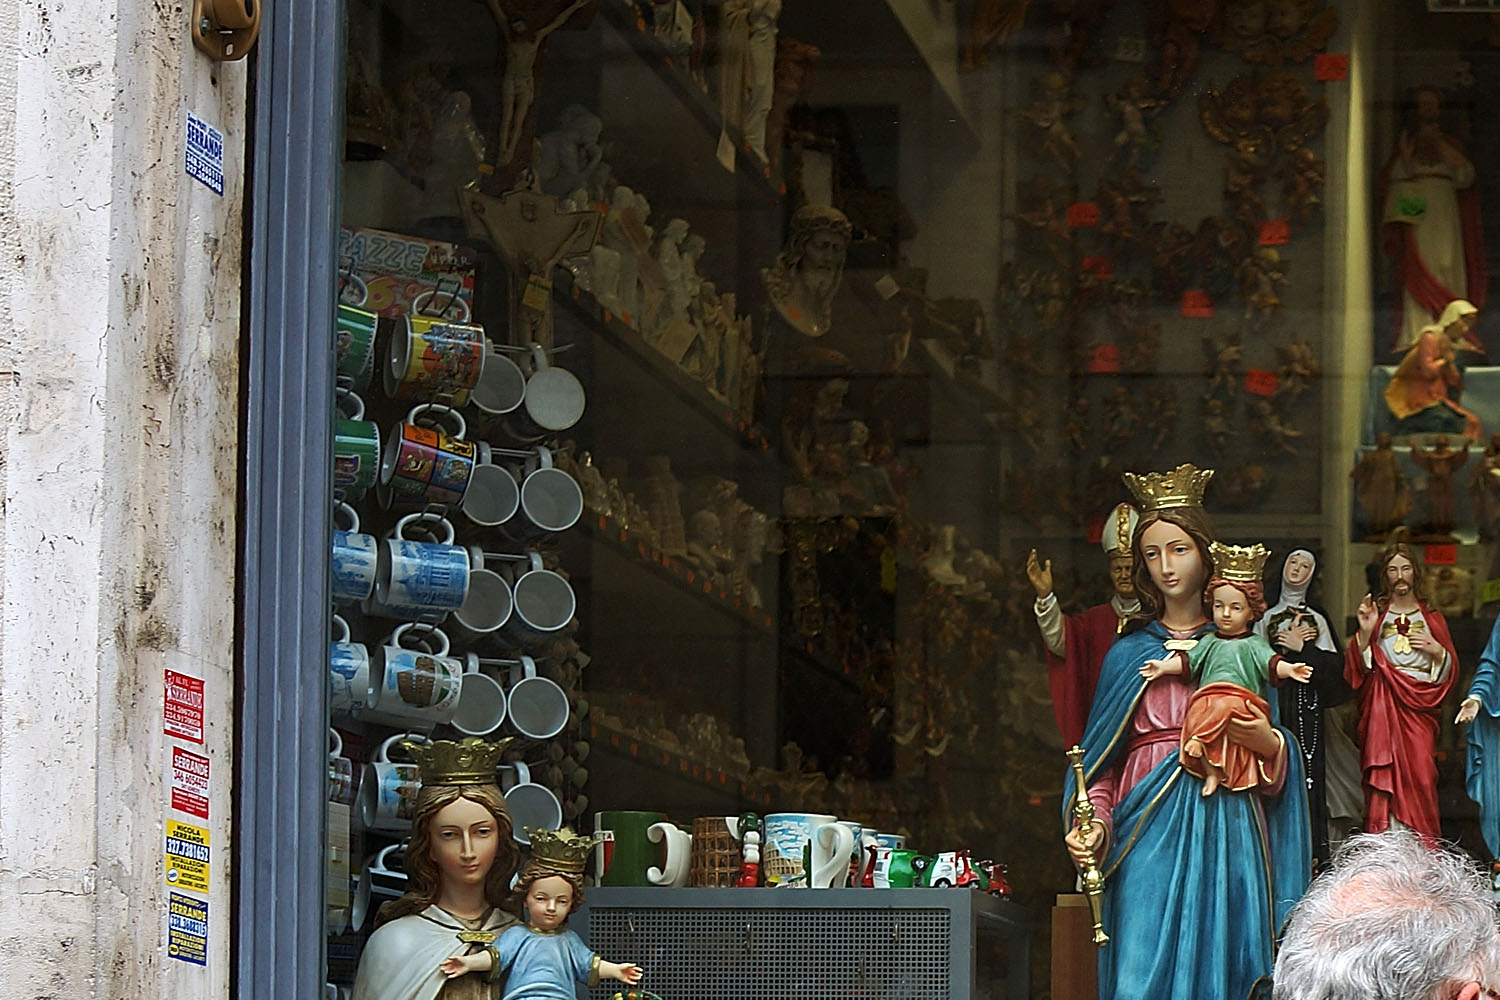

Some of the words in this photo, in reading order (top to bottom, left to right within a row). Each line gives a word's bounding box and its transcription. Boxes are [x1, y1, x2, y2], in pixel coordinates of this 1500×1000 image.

[172, 830, 205, 844] SERRANDE
[177, 824, 201, 836] NICOLA
[170, 902, 207, 922] SERRANDE
